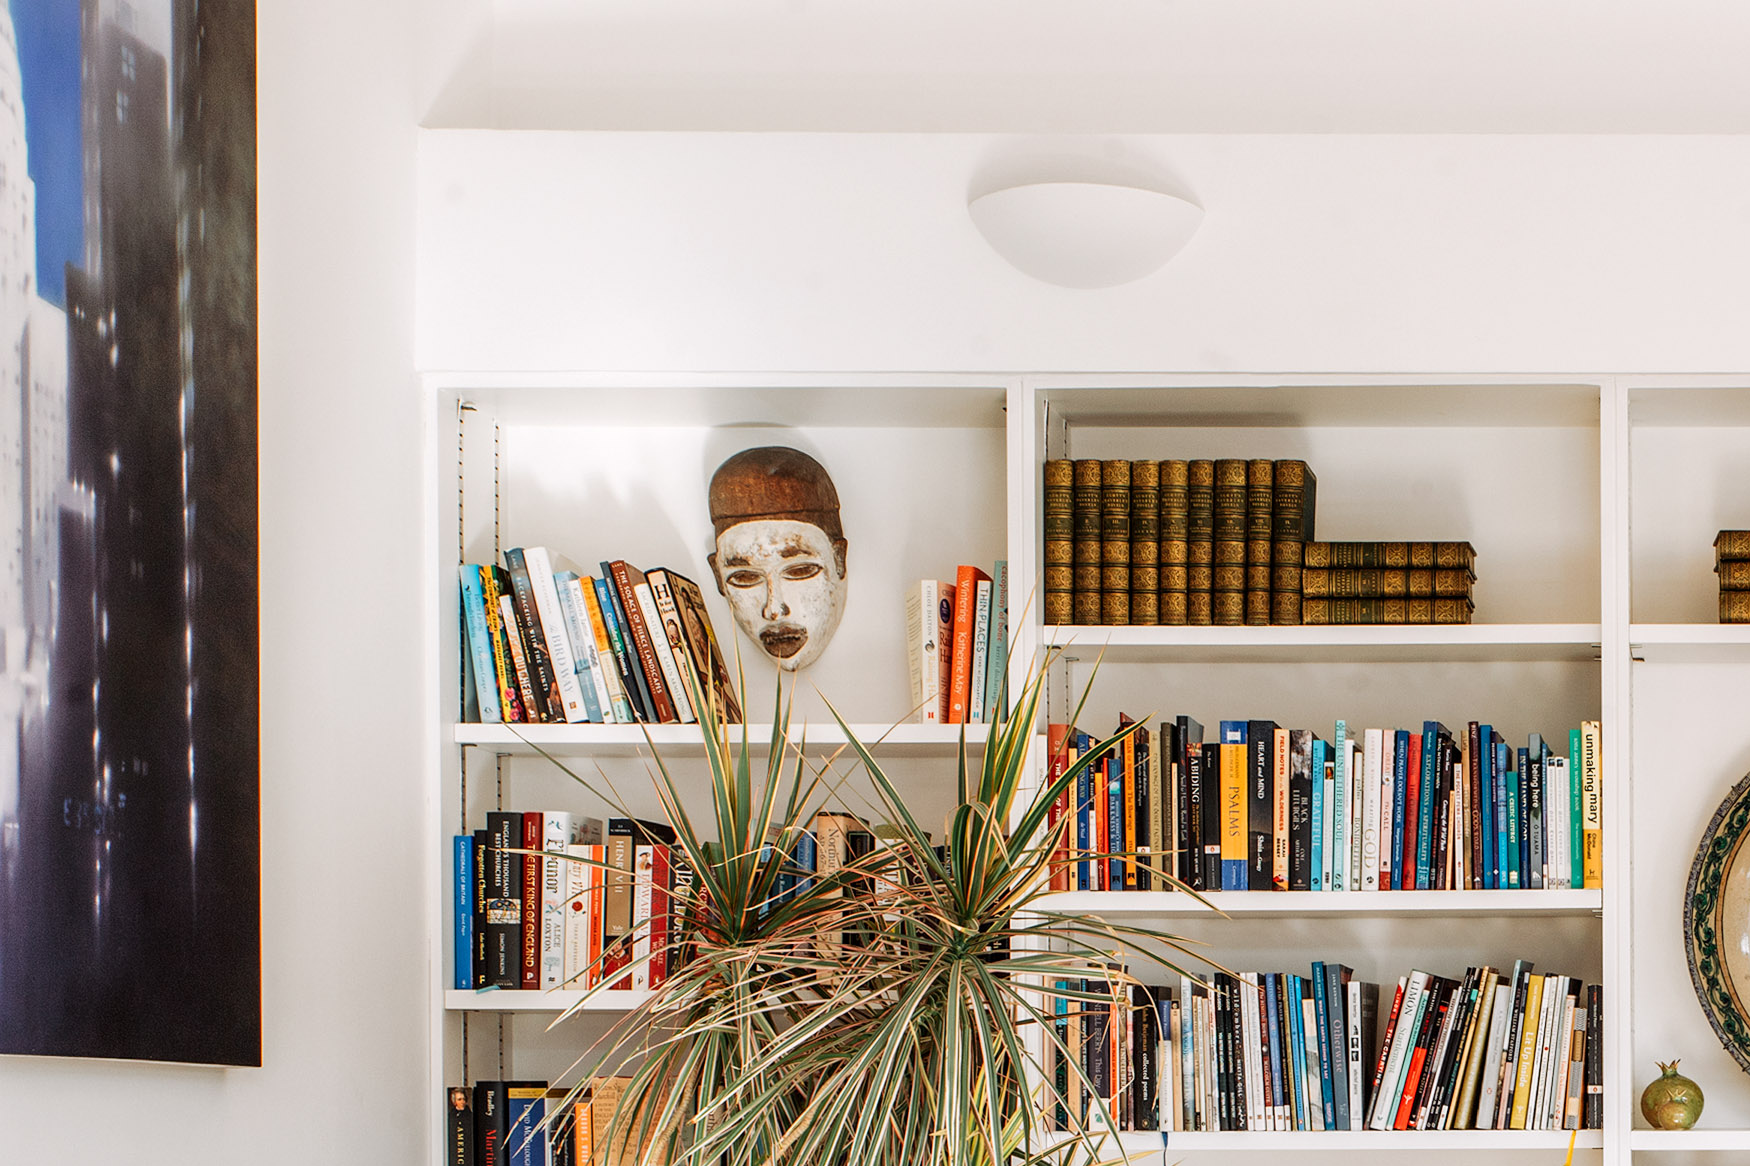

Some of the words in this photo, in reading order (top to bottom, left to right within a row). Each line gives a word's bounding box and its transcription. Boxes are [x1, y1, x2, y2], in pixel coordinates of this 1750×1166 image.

[619, 570, 629, 584] THE
[624, 586, 637, 613] SOLACE
[958, 580, 970, 623] Wintering
[979, 588, 988, 611] THIN
[632, 614, 641, 624] OF
[518, 577, 532, 626] BACKPACKING
[529, 628, 539, 648] WITH
[534, 650, 542, 664] THE
[539, 667, 549, 692] SAINTS
[635, 625, 647, 648] FIERCE
[976, 615, 987, 653] PLACES
[956, 631, 968, 672] Katherine
[644, 649, 662, 695] LANDSCAPES
[954, 675, 965, 695] May
[1530, 764, 1541, 787] being
[1584, 734, 1596, 792] unmaking
[1191, 758, 1200, 803] ABIDING
[1230, 786, 1239, 836] PSALMS
[1531, 789, 1540, 808] here
[1587, 794, 1599, 823] mary
[1312, 792, 1320, 848] GRATEFUL
[526, 864, 535, 886] FIRST
[526, 887, 535, 909] KING
[525, 911, 535, 922] OF
[525, 924, 534, 967] ENGLAND
[544, 918, 552, 952] LOXTON
[553, 923, 561, 948] ALICE
[1404, 980, 1419, 1016] LIMÓN
[1332, 1019, 1345, 1073] Otherwise
[1387, 1026, 1407, 1074] Startlement
[1524, 1031, 1534, 1045] Lit
[1142, 1053, 1150, 1079] collected
[1521, 1047, 1532, 1060] Up
[1519, 1062, 1530, 1088] Inside
[486, 1090, 495, 1117] Bradley
